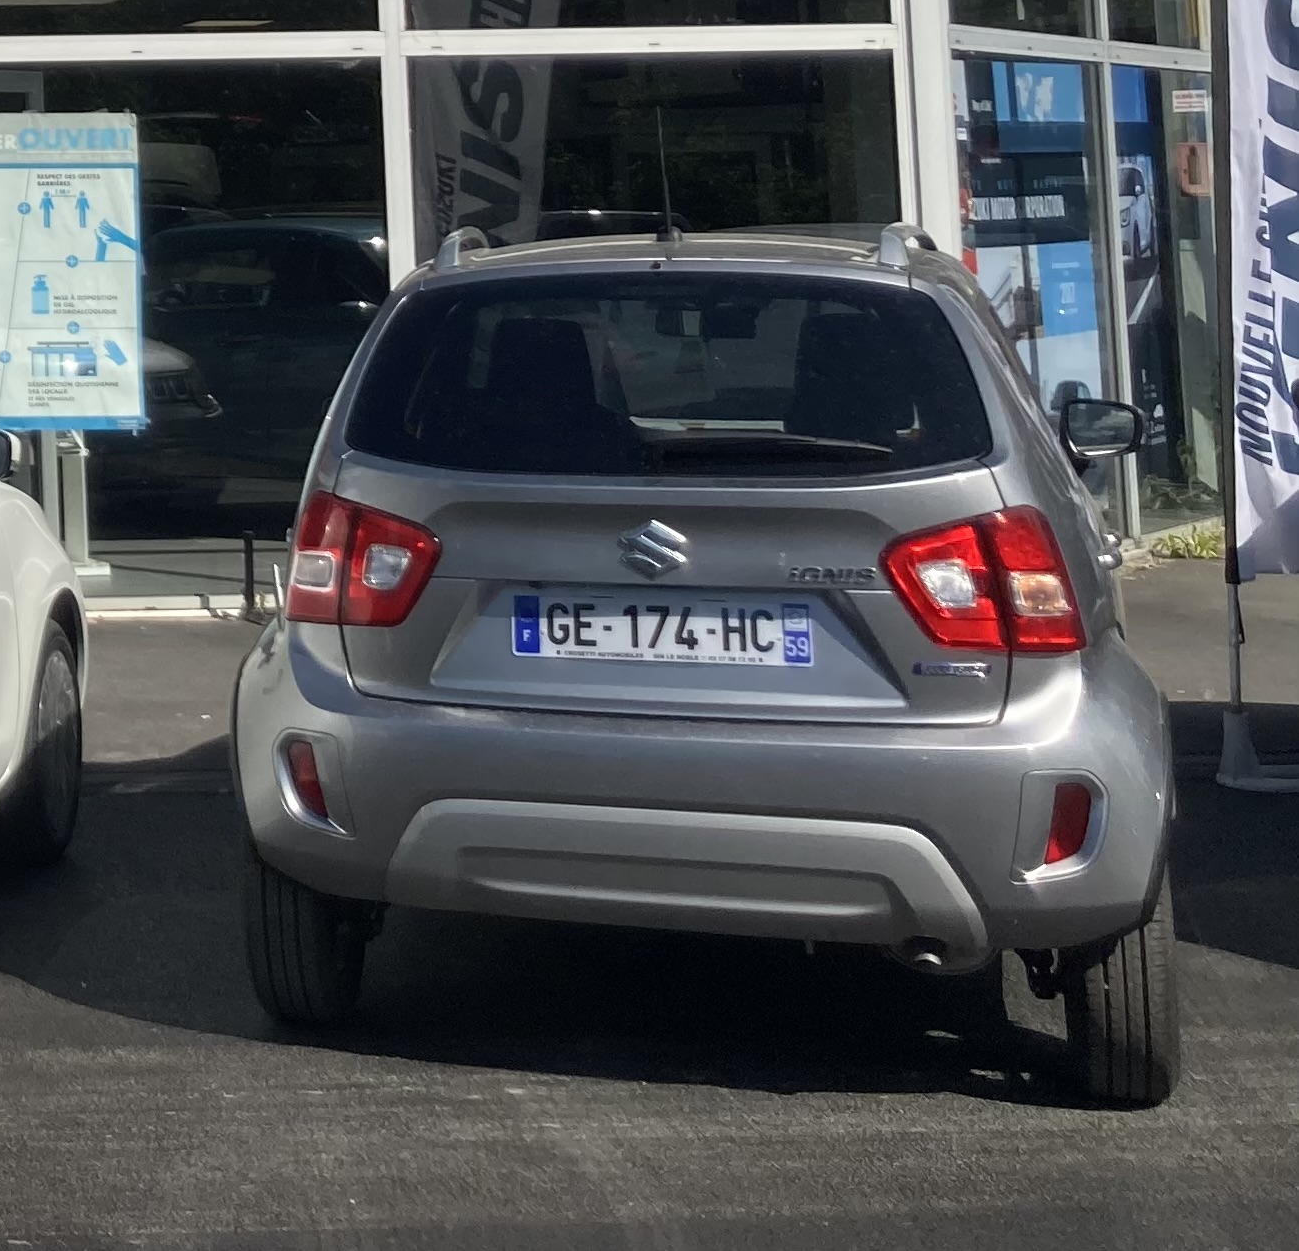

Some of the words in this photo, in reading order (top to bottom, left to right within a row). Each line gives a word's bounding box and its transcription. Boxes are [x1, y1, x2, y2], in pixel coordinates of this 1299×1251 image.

[18, 127, 133, 151] OUVERT
[522, 629, 532, 642] F
[546, 602, 775, 653] GE-174-HC
[785, 635, 810, 658] 59
